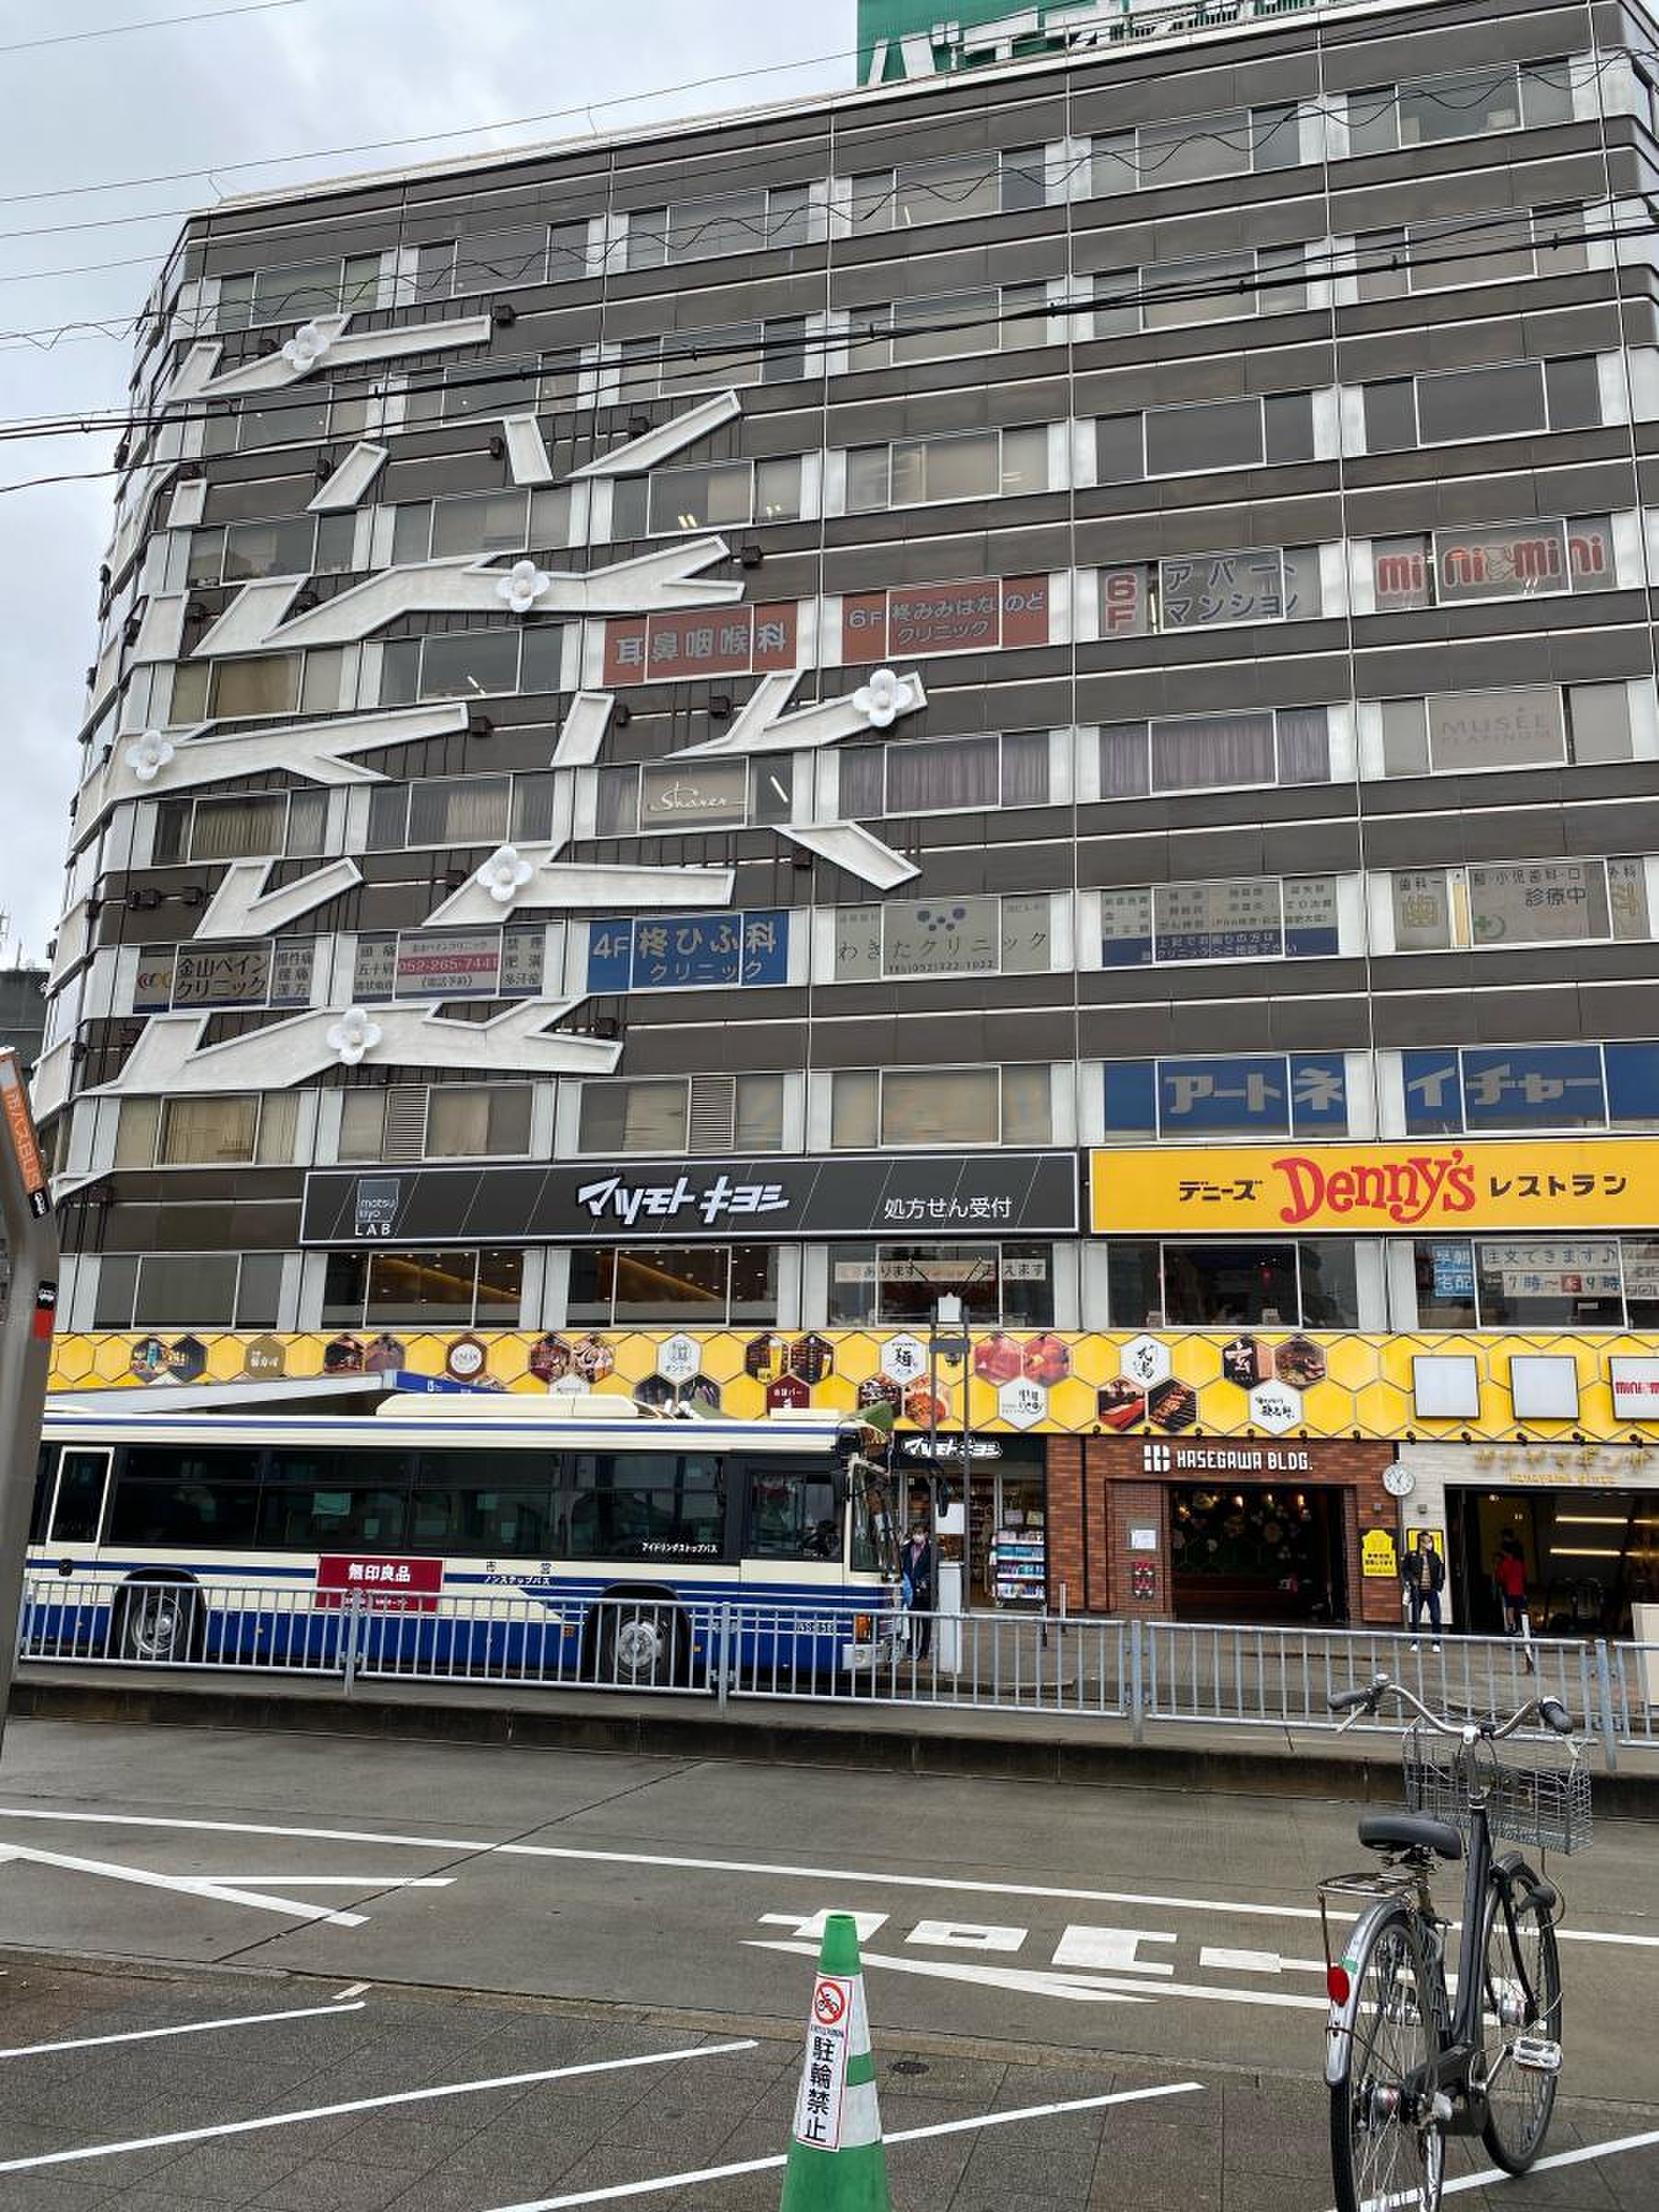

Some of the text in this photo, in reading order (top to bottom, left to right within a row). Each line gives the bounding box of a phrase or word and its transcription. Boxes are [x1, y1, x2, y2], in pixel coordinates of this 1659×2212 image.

[849, 610, 884, 629] 6F
[616, 622, 786, 666] 耳鼻咽喉科
[898, 620, 988, 644] クリニック
[1525, 887, 1586, 907] 診療中
[591, 922, 776, 959] 4F 柊ひふ科
[178, 954, 266, 978] 金山ペイン
[649, 959, 762, 984] クリニック
[177, 977, 266, 1000] クリニック
[1179, 1149, 1628, 1224] デニーズ Denny's レストラン
[883, 1196, 1012, 1220] 処方せん受付
[355, 1223, 392, 1237] LAB
[1177, 1450, 1313, 1471] HASEGAWA BLDG.
[348, 1562, 411, 1583] 無印良品
[805, 2036, 835, 2143] 駐輪禁止
